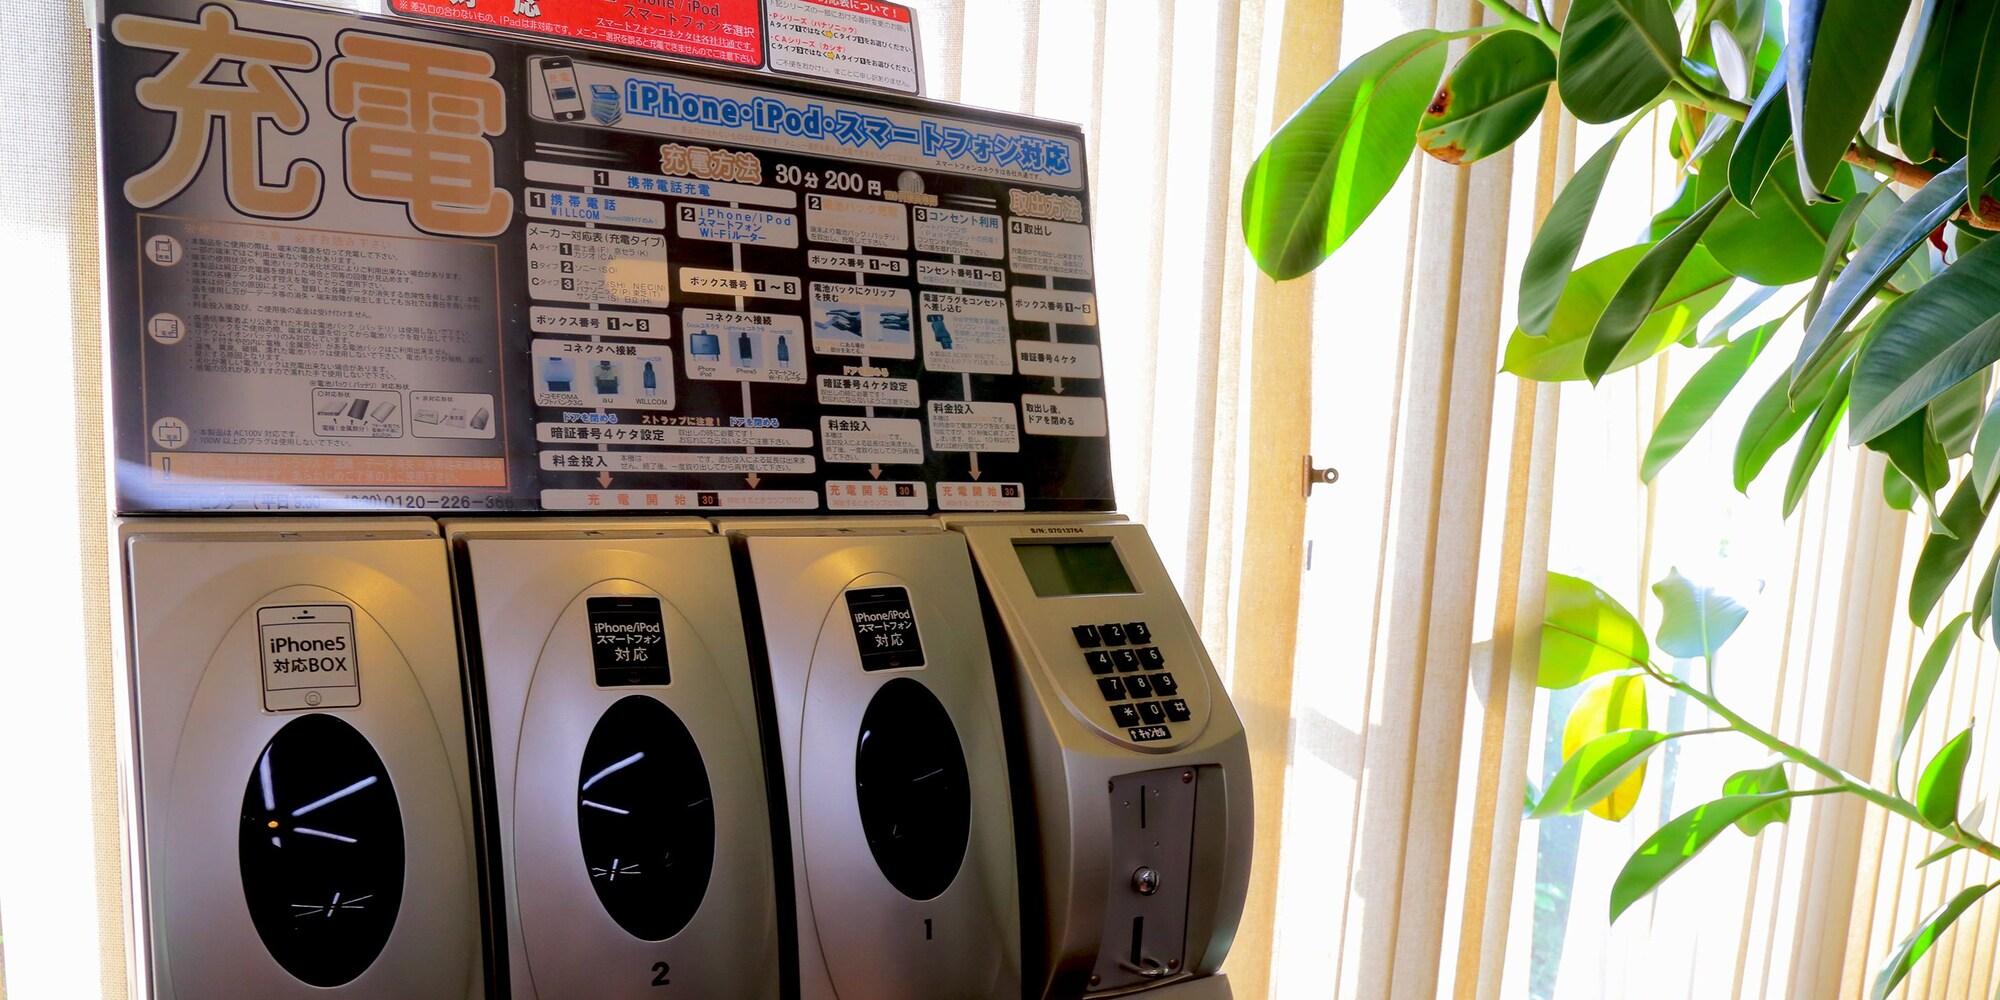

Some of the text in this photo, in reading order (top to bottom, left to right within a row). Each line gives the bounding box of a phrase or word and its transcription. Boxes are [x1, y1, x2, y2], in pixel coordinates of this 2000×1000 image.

[624, 5, 755, 37] スマートフォンを選択
[111, 2, 513, 237] 充電
[660, 143, 761, 185] 充電方法
[628, 176, 711, 197] 携帯電話充電
[551, 193, 616, 212] 携帯電話
[1009, 188, 1083, 224] 取出方法
[550, 207, 600, 220] WILLCOM
[930, 211, 999, 229] コンセント利用
[699, 218, 762, 232] スマートフォン
[1024, 224, 1052, 236] 取出し
[700, 228, 767, 242] Wi-Fiルーター
[812, 255, 864, 268] ボックス番号
[690, 277, 748, 290] ボックス番号
[814, 284, 896, 298] 電池パックにクリップ
[815, 293, 839, 303] を挟む
[923, 293, 1006, 308] 電源プラグをコンセント
[924, 303, 962, 313] へ差し込む
[537, 315, 600, 328] ボックス番号
[705, 312, 772, 325] コネクタへ接続
[563, 343, 637, 356] コネクタへ接続
[1021, 352, 1077, 364] 暗証番号4ケタ
[823, 379, 908, 392] 暗証番号4ケタ設定
[934, 403, 974, 415] 料金投入
[828, 420, 870, 432] 料金投入
[1027, 415, 1075, 426] ドアを閉める
[550, 427, 665, 441] 暗証番号4ケタ設定
[553, 455, 608, 467] 料金投入
[830, 484, 889, 496] 充電開始
[943, 485, 1015, 497] 充電開始 30
[587, 493, 686, 506] 充電開始
[702, 495, 714, 504] 30
[854, 609, 911, 623] iPhone/iPod
[594, 622, 660, 633] iPhone/iPod
[858, 621, 912, 633] スマートフォン
[1087, 625, 1145, 637] 1 2 3
[270, 636, 346, 653] iPhone5
[596, 634, 661, 645] スマートフォン
[875, 632, 904, 648] 対応
[614, 647, 648, 661] 対応
[1099, 650, 1158, 663] 4 5 6
[273, 656, 347, 673] 対応BOX
[1111, 676, 1171, 690] 7 8 9
[1151, 704, 1159, 714] 0
[924, 918, 932, 940] 1
[651, 961, 670, 986] 2
